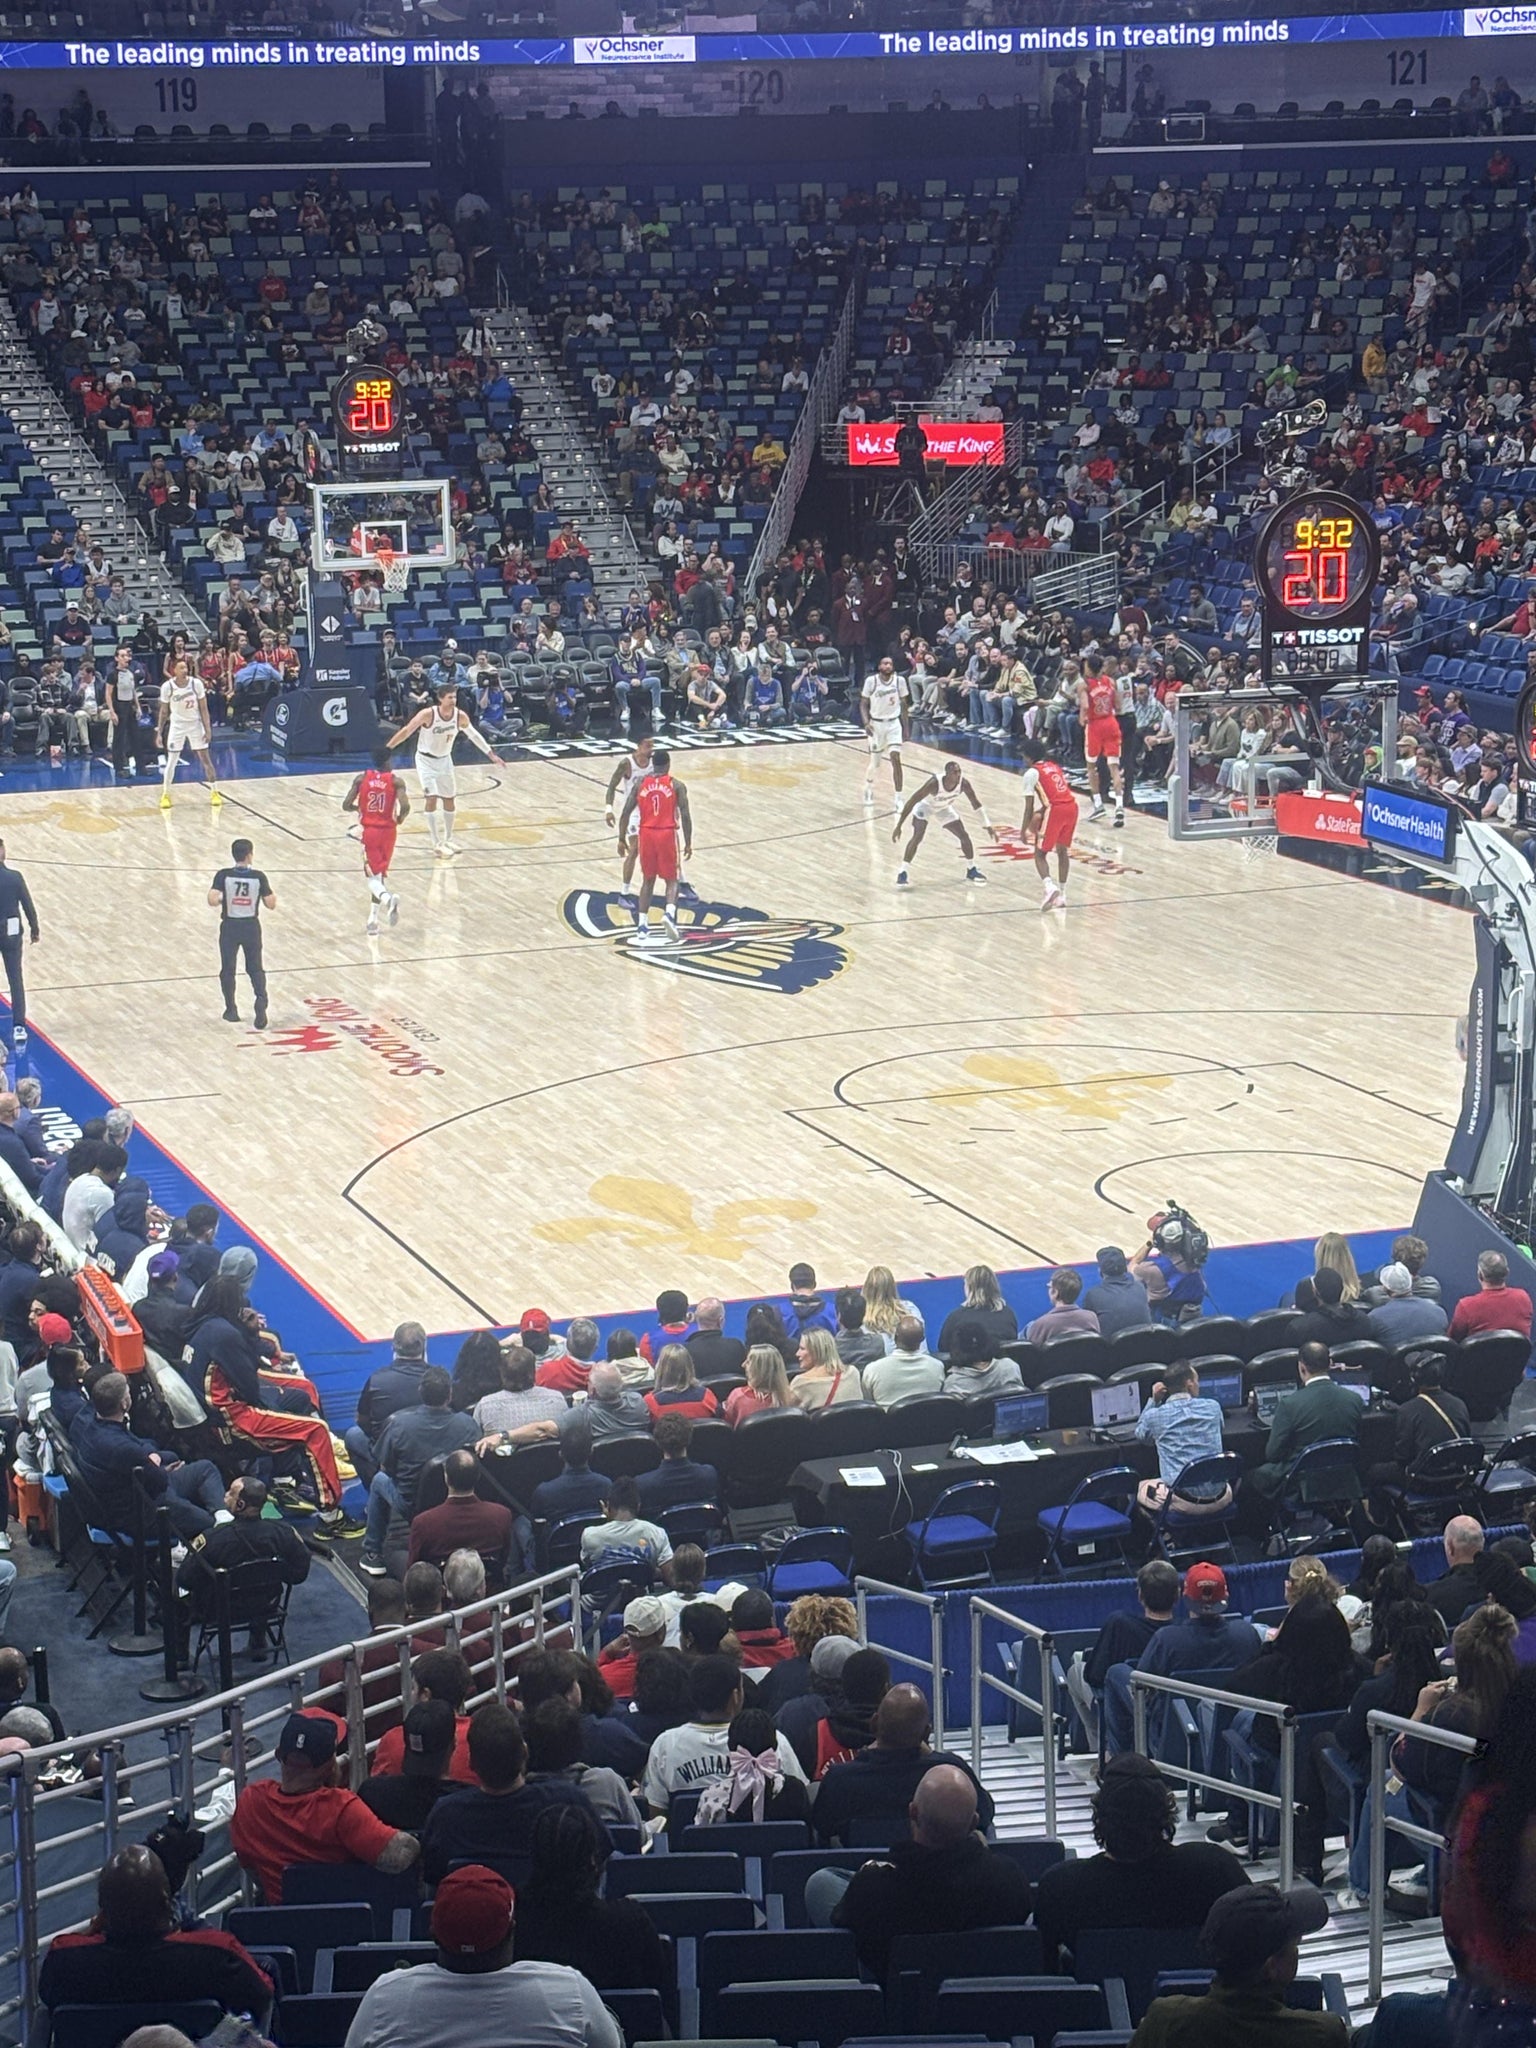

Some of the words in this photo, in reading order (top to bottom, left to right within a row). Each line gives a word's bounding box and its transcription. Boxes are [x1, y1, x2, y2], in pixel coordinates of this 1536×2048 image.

[599, 37, 664, 53] Ochsner
[879, 32, 922, 53] The
[928, 29, 1012, 53] leading
[1019, 27, 1088, 49] minds
[1095, 26, 1116, 46] in
[1123, 23, 1215, 47] treating
[1222, 19, 1289, 42] minds
[65, 43, 110, 64] The
[117, 43, 205, 67] leading
[211, 42, 281, 64] minds
[288, 42, 309, 62] in
[315, 42, 406, 66] treating
[413, 41, 480, 61] minds
[1387, 49, 1427, 86] 121
[155, 77, 197, 113] 119
[738, 69, 783, 104] 120
[356, 380, 391, 399] 9:32
[349, 400, 391, 431] 20
[359, 442, 400, 453] TISSOT
[883, 438, 956, 453] STHIE
[1296, 519, 1353, 550] 9:32
[1283, 551, 1347, 606] 20
[1297, 627, 1365, 645] TISSOT
[651, 794, 660, 817] 1
[234, 881, 250, 897] 73
